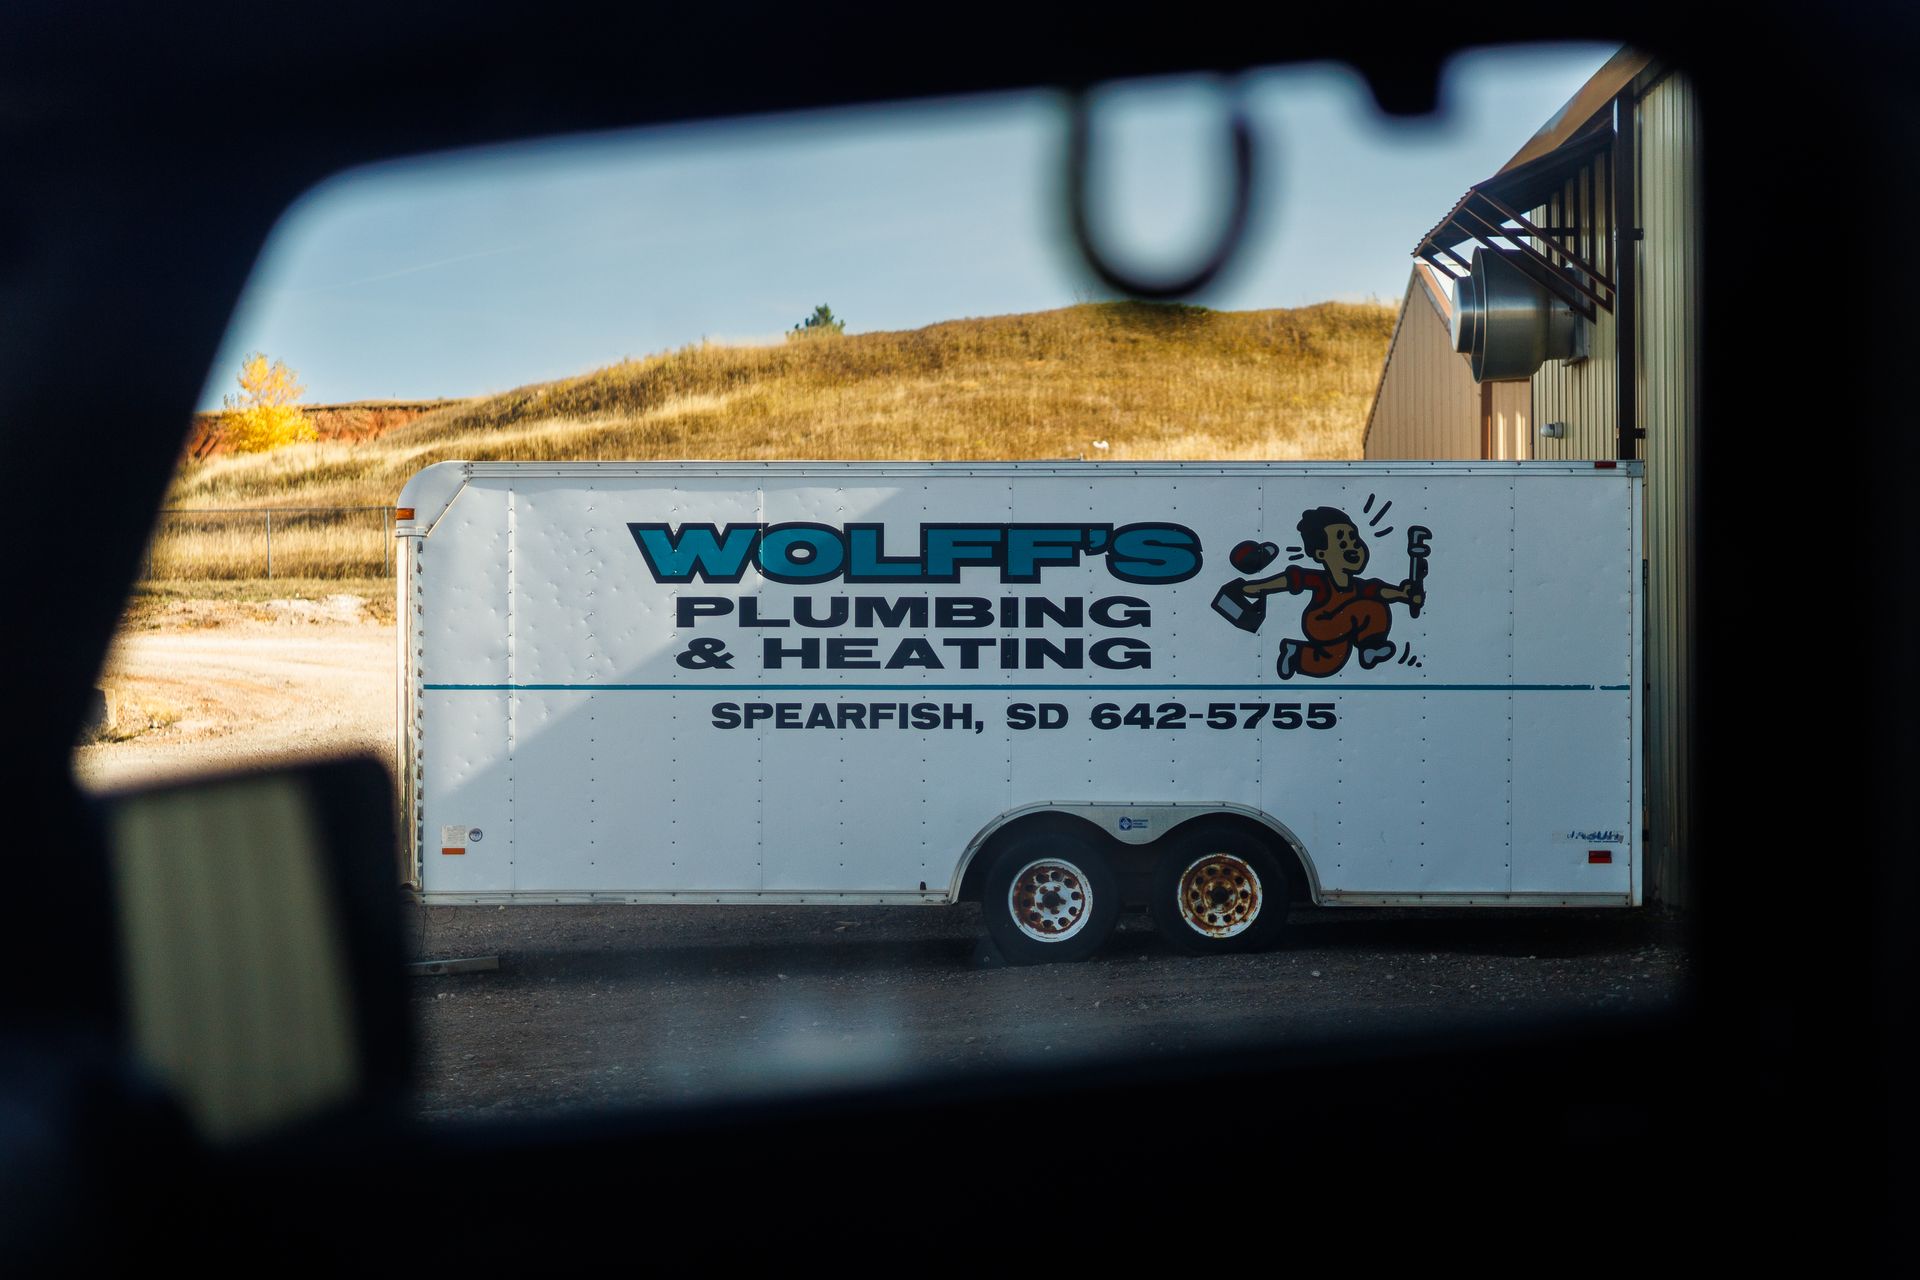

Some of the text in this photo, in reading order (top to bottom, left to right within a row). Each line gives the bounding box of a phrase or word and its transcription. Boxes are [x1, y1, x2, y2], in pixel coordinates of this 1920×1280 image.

[627, 522, 1203, 584] WOLFF'S
[676, 596, 1151, 628] PLUMBING
[675, 637, 1151, 669] & HEATING
[711, 702, 1337, 734] SPEARFISH, SD 642-5755
